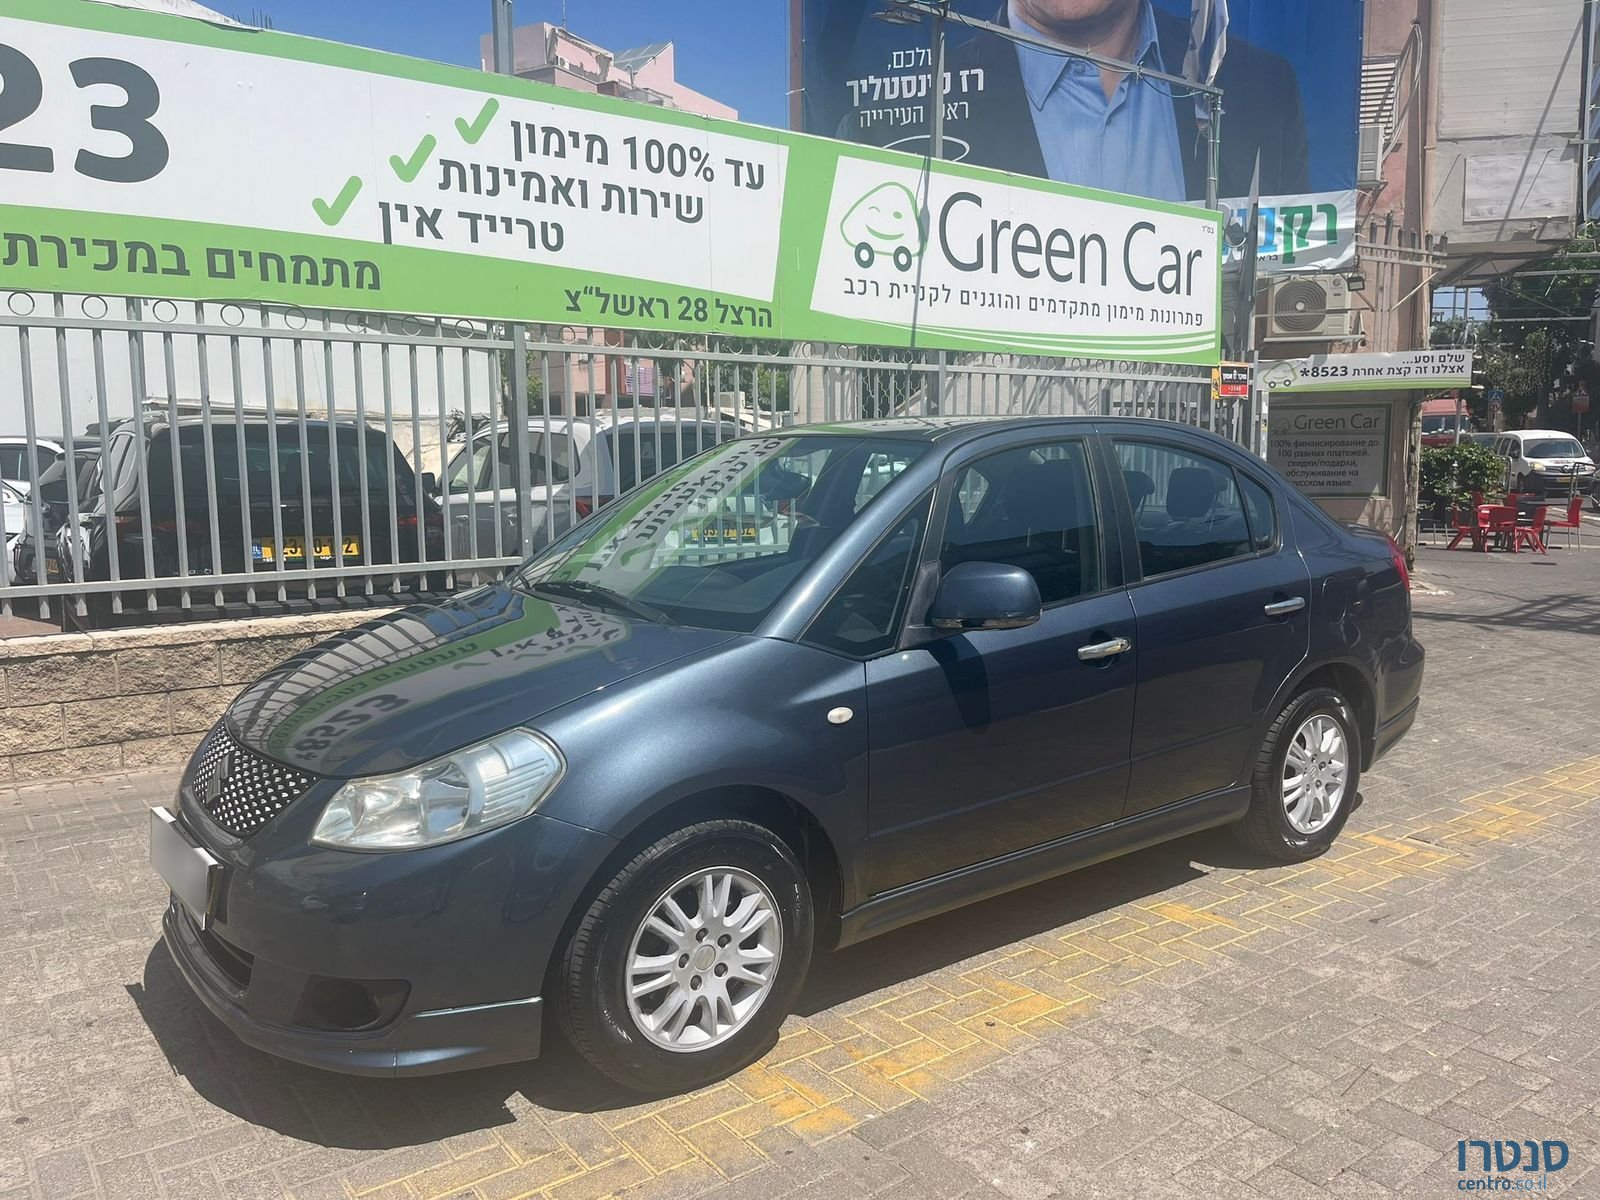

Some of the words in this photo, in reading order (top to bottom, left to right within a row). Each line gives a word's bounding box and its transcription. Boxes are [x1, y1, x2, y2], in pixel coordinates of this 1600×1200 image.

[960, 68, 985, 93] רז
[860, 105, 924, 128] העירייה
[511, 119, 609, 167] מימון
[622, 135, 715, 183] 100%
[438, 158, 589, 210] ואמינות
[725, 157, 765, 190] עד
[601, 182, 704, 225] שירות
[378, 200, 444, 246] אין
[457, 210, 565, 253] טרייד
[2, 232, 191, 277] במכירת
[938, 191, 1108, 287] Green
[1123, 221, 1203, 297] Car
[206, 247, 382, 291] מתמחים
[843, 277, 880, 297] רכב
[888, 280, 952, 305] לקניית
[677, 295, 709, 322] 28
[715, 297, 773, 328] הרצל
[960, 291, 1021, 311] והוגנים
[1029, 296, 1101, 320] מתקדמים
[1107, 303, 1145, 323] מימון
[1150, 308, 1204, 327] פתרונות
[1431, 364, 1464, 375] אצלנו
[1438, 353, 1465, 363] שלם
[1352, 368, 1383, 377] אחרת
[1386, 367, 1412, 377] קצת
[1415, 366, 1429, 375] זה
[1294, 414, 1345, 430] Green
[1350, 413, 1380, 429] Car
[1278, 449, 1292, 457] 100
[1368, 440, 1379, 448] до
